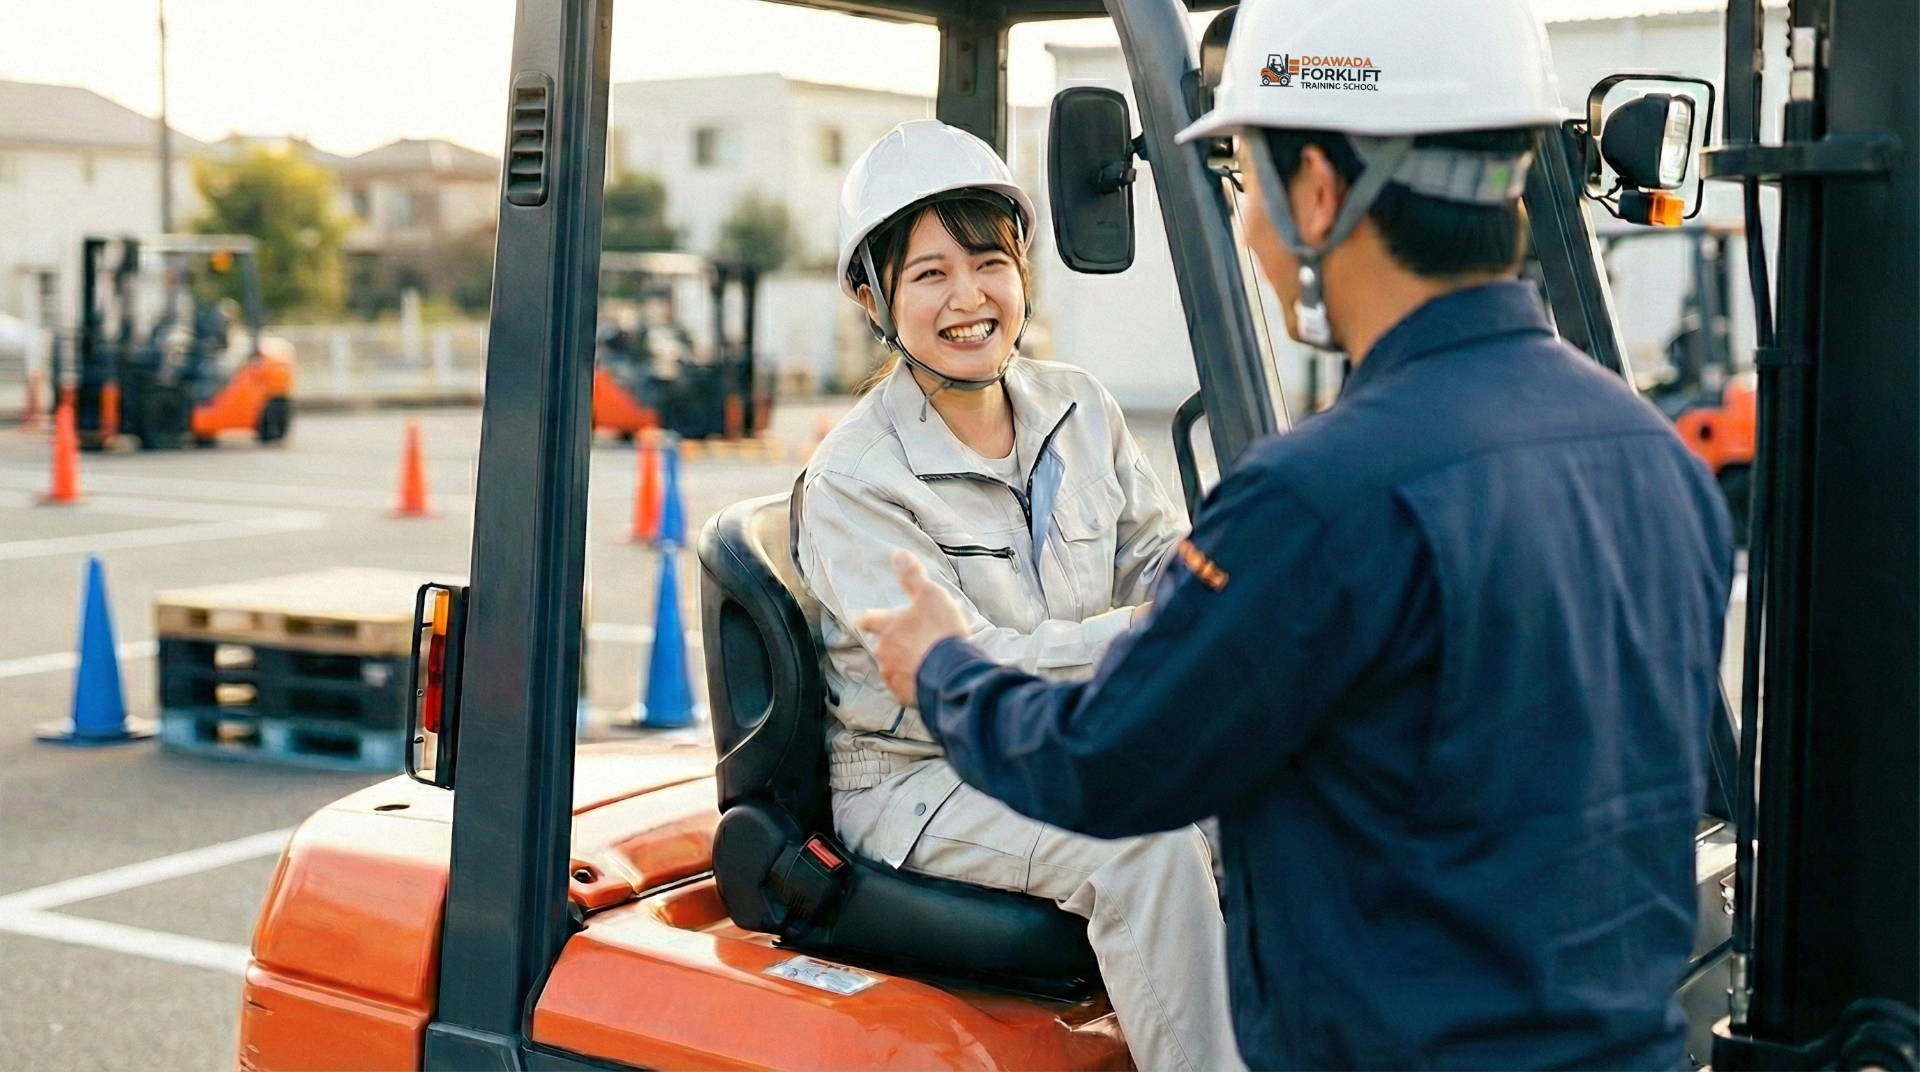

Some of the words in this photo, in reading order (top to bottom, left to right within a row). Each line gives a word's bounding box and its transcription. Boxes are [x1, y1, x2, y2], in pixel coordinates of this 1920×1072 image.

[1301, 56, 1373, 68] DOAWADA
[1301, 68, 1382, 82] FORKLIFT
[1343, 82, 1378, 91] SCHOOL
